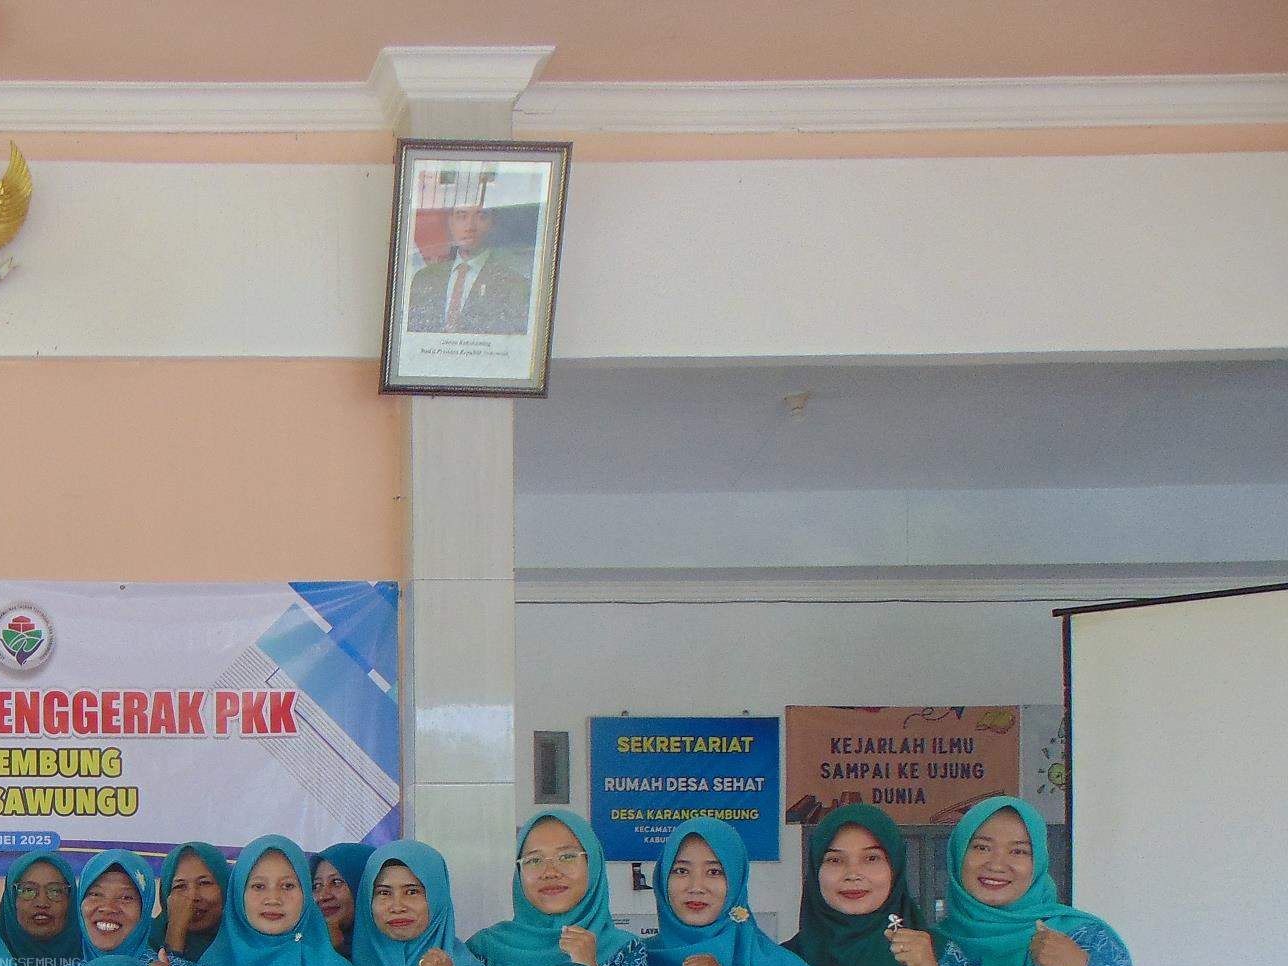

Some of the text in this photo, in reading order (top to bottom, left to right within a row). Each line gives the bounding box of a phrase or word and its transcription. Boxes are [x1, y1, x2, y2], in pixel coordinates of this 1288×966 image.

[214, 689, 299, 736] PKK
[616, 735, 754, 753] SEKRETARIAT
[830, 736, 974, 754] KEJARLAH ILMU
[819, 762, 985, 780] SAMPAI KE UJUNG
[604, 777, 765, 792] RUMAH DESA SEHAT
[871, 787, 926, 805] DUNIA
[611, 809, 760, 820] DESA KARANGSEMBUNG
[634, 825, 676, 833] KECAMAT
[20, 835, 52, 846] 2025
